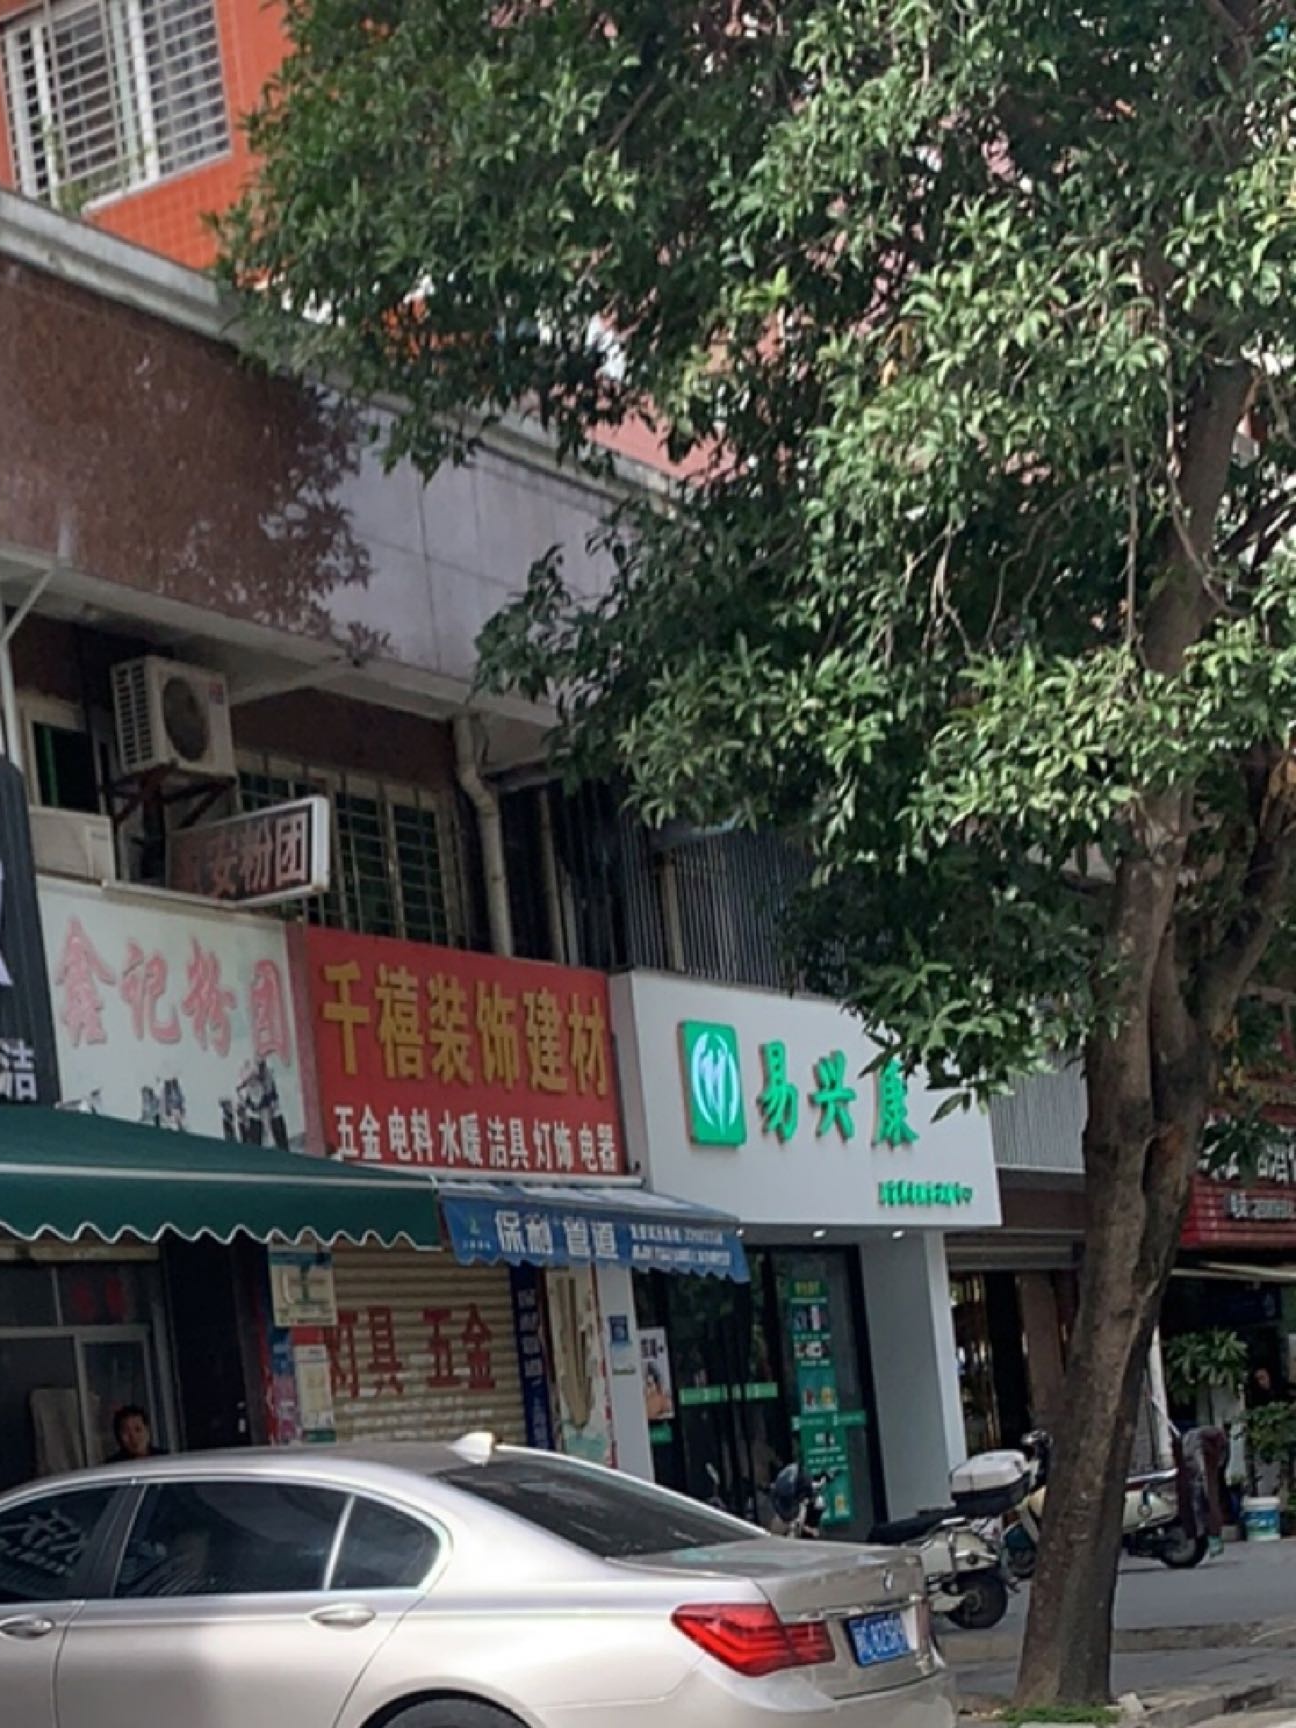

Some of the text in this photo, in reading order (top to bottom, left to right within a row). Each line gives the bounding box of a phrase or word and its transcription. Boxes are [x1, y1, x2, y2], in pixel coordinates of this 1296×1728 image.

[323, 959, 608, 1097] 千禧装饰建材
[762, 1040, 919, 1146] 易兴康
